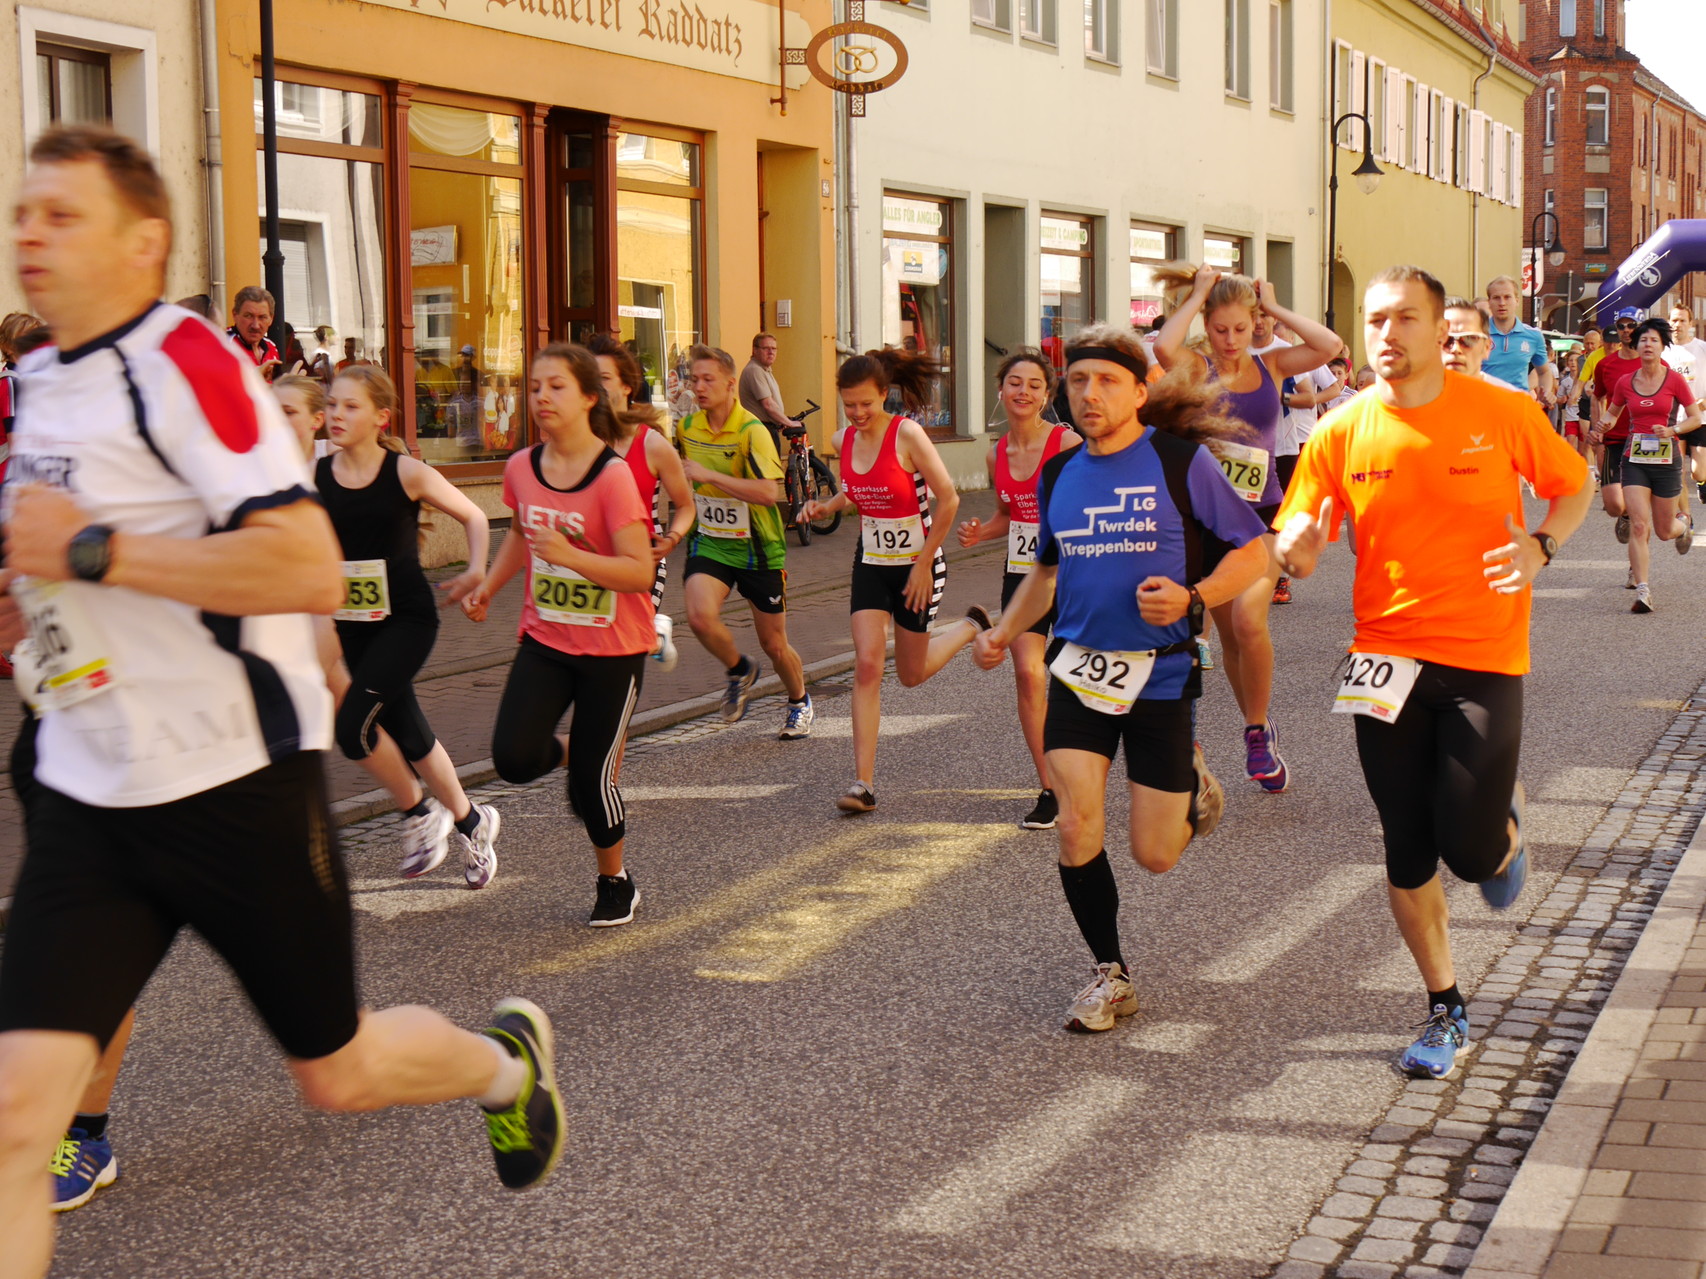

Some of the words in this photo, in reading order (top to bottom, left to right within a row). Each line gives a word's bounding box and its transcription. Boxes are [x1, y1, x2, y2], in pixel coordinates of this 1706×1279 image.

[638, 2, 743, 68] Raddatz
[1449, 467, 1479, 475] Dustin
[851, 485, 889, 493] Sparkasse
[1017, 500, 1038, 508] Elbe-
[1133, 497, 1157, 511] LG
[519, 502, 585, 537] LET'S
[703, 506, 737, 524] 405
[1098, 517, 1157, 533] Twrdek
[872, 529, 911, 548] 192
[1064, 538, 1157, 558] Treppenbau
[350, 581, 380, 605] 53
[537, 578, 608, 610] 2057
[1069, 652, 1130, 690] 292
[1344, 658, 1393, 688] 420
